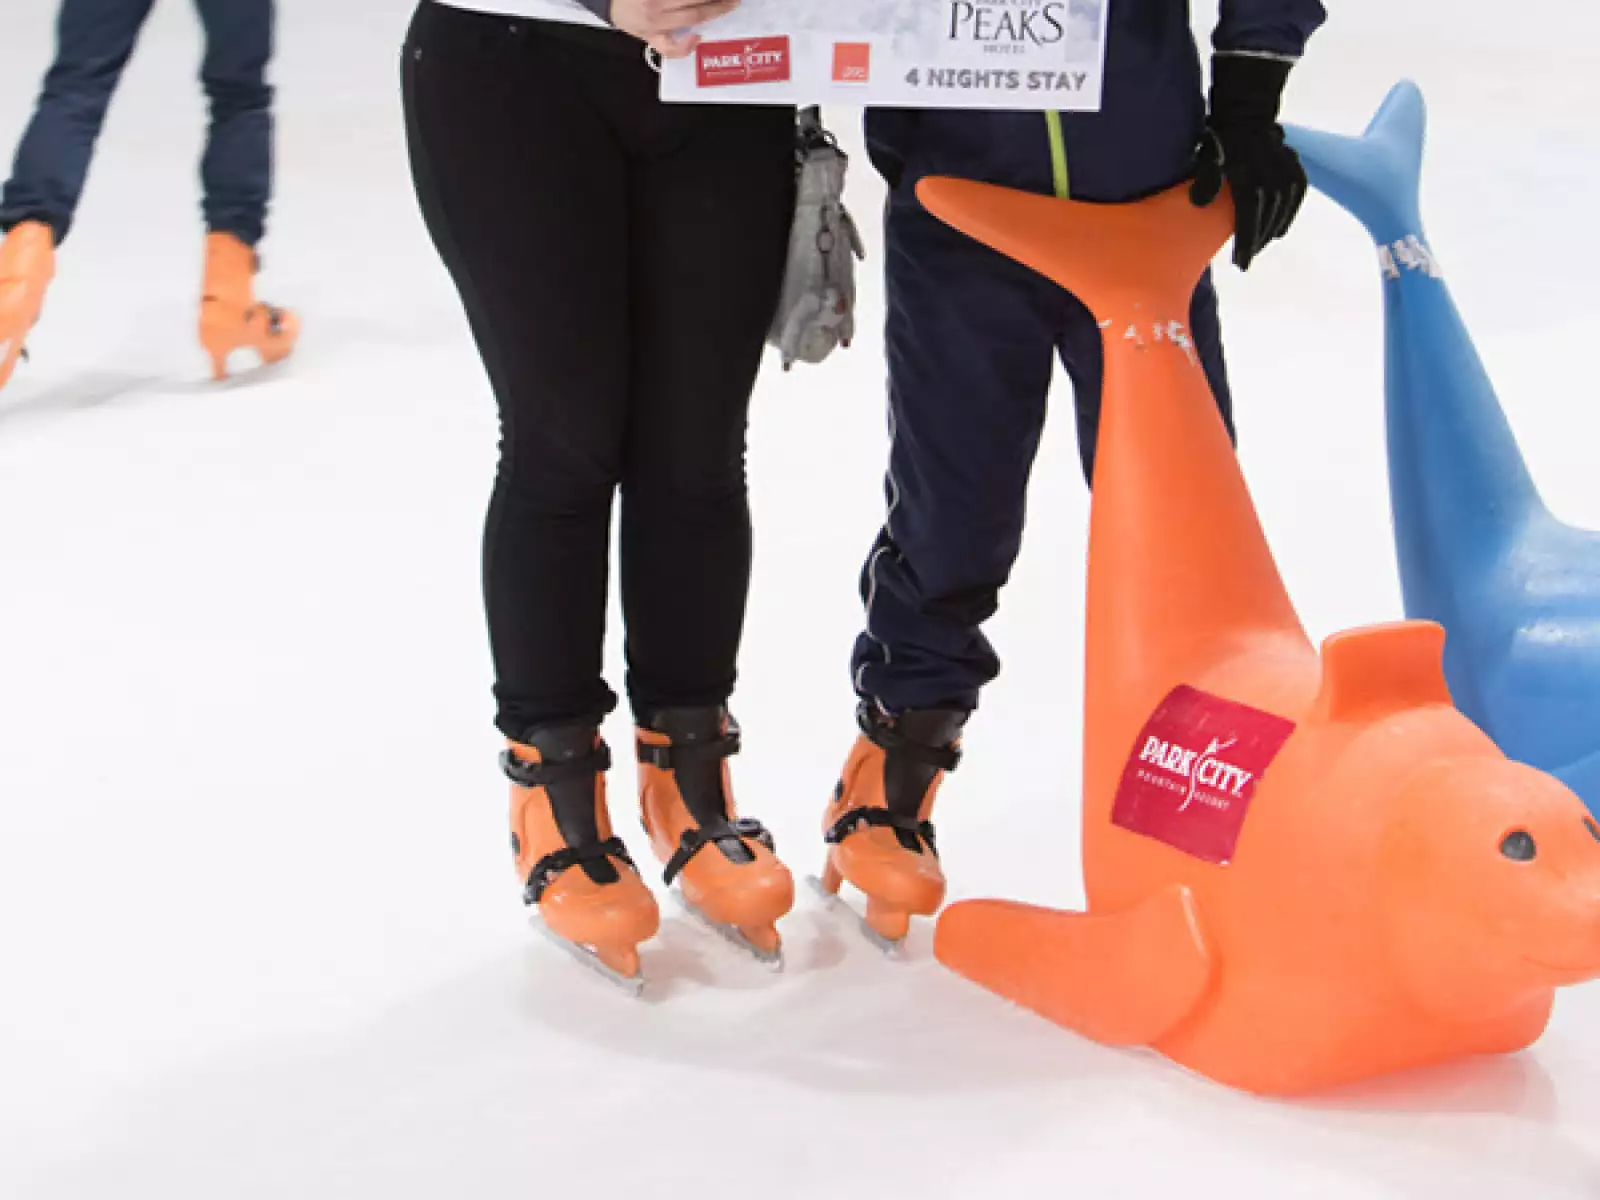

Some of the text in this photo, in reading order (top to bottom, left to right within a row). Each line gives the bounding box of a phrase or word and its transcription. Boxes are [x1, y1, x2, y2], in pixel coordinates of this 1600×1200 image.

[949, 0, 1065, 46] PEAKS
[702, 50, 783, 70] PARK CITY
[983, 44, 1025, 55] HOTEL
[904, 67, 1088, 91] 4 NIGHTS STAY
[1138, 734, 1253, 798] PARK CITY
